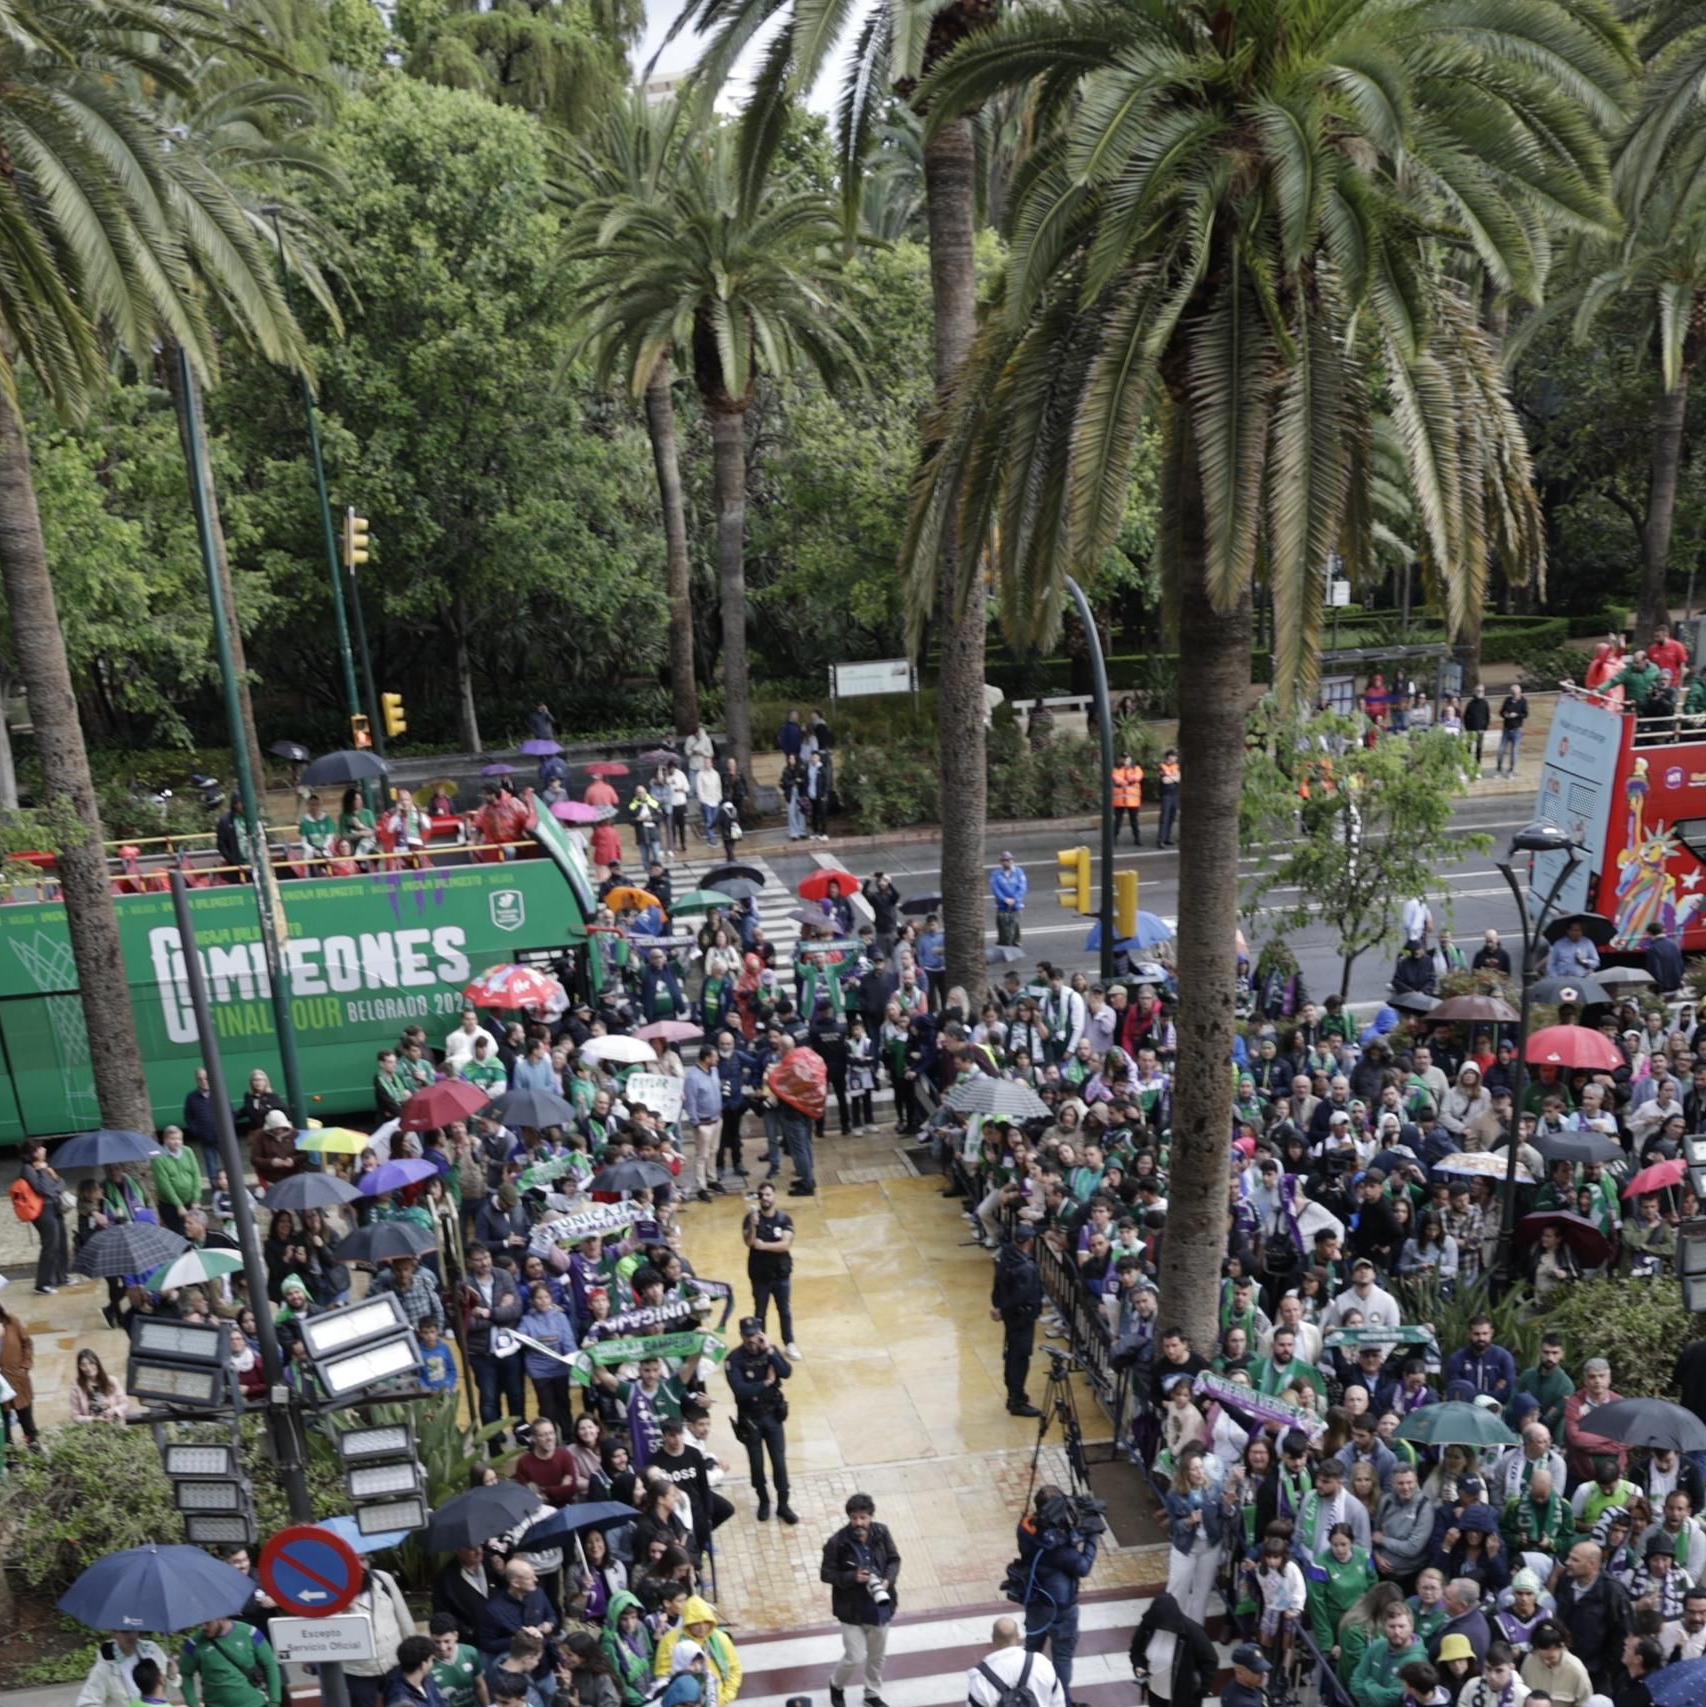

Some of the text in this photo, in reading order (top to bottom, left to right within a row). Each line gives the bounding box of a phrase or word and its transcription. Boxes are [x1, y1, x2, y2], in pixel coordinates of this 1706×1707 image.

[212, 1002, 275, 1038] INAL
[293, 996, 343, 1032] OUR
[347, 993, 428, 1023] BELGRADO
[302, 1629, 341, 1640] Excepto
[287, 1639, 361, 1652] Servicio Oficial
